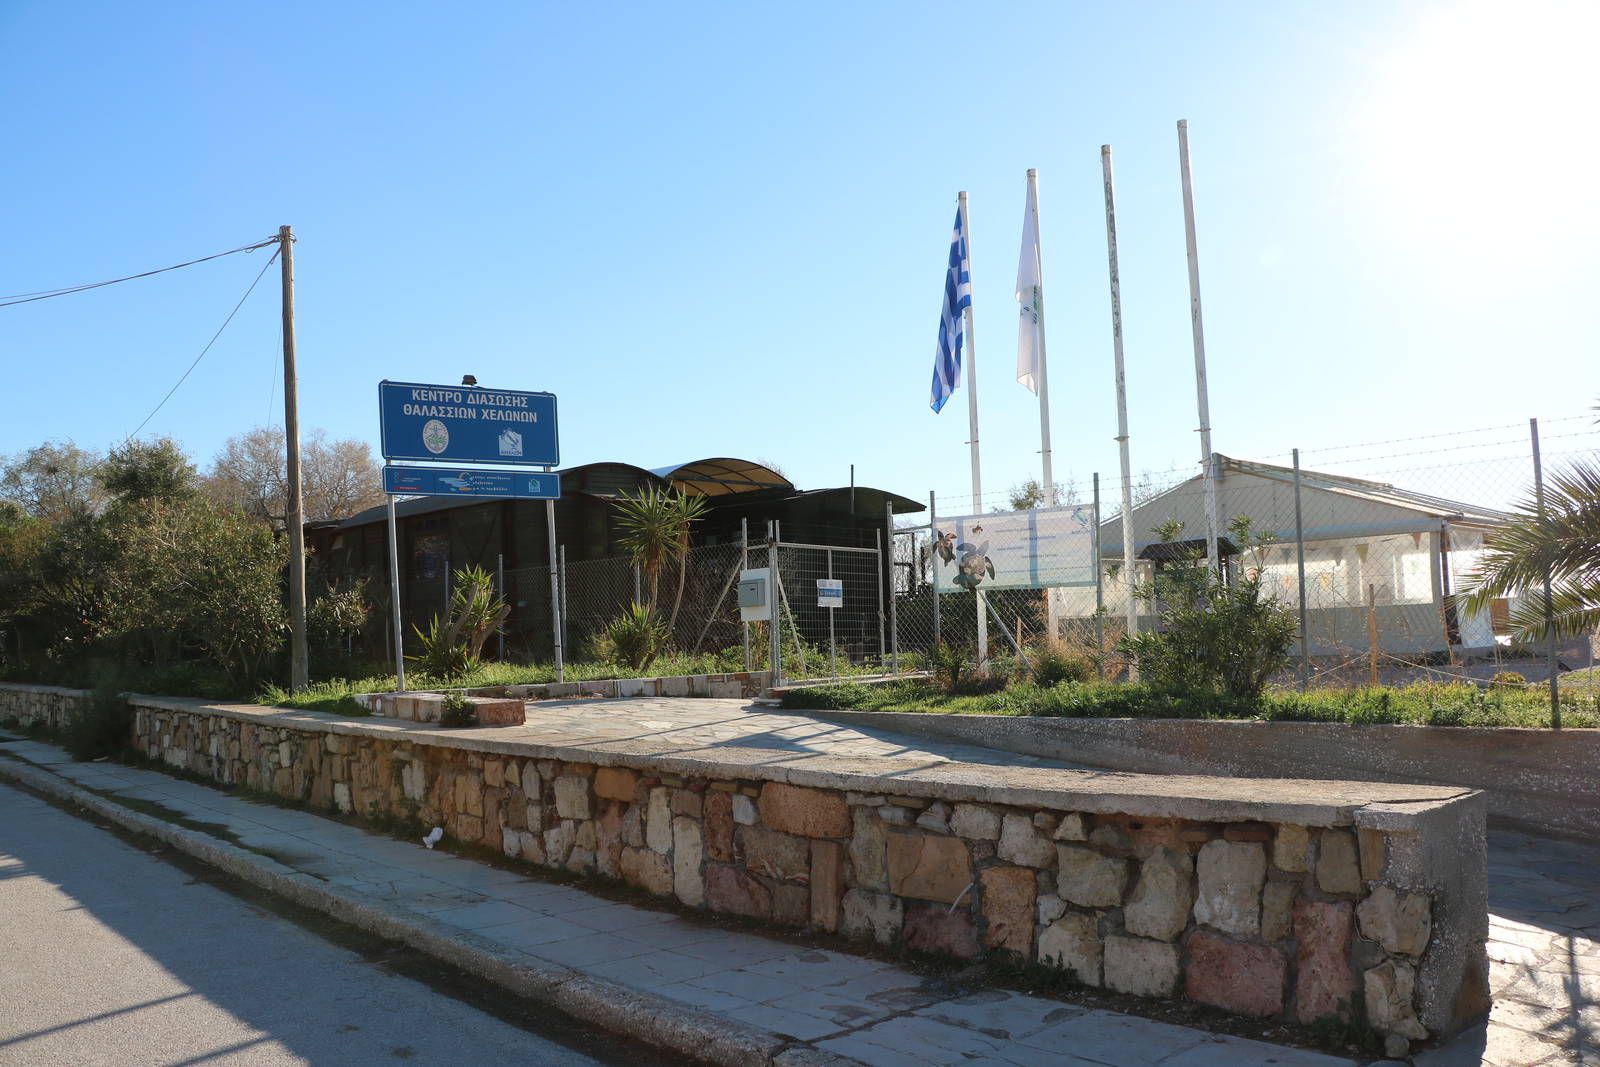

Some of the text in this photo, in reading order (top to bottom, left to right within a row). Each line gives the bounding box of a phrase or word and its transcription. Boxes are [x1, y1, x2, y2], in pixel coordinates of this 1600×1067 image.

[412, 389, 528, 408] ΚΕΝΤΡΟ ΔΙΑΣΩΣΗΣ
[403, 404, 537, 423] ΘΑΛΑΣΣΙΩΝ ΧΕΛΩΝΩΝ
